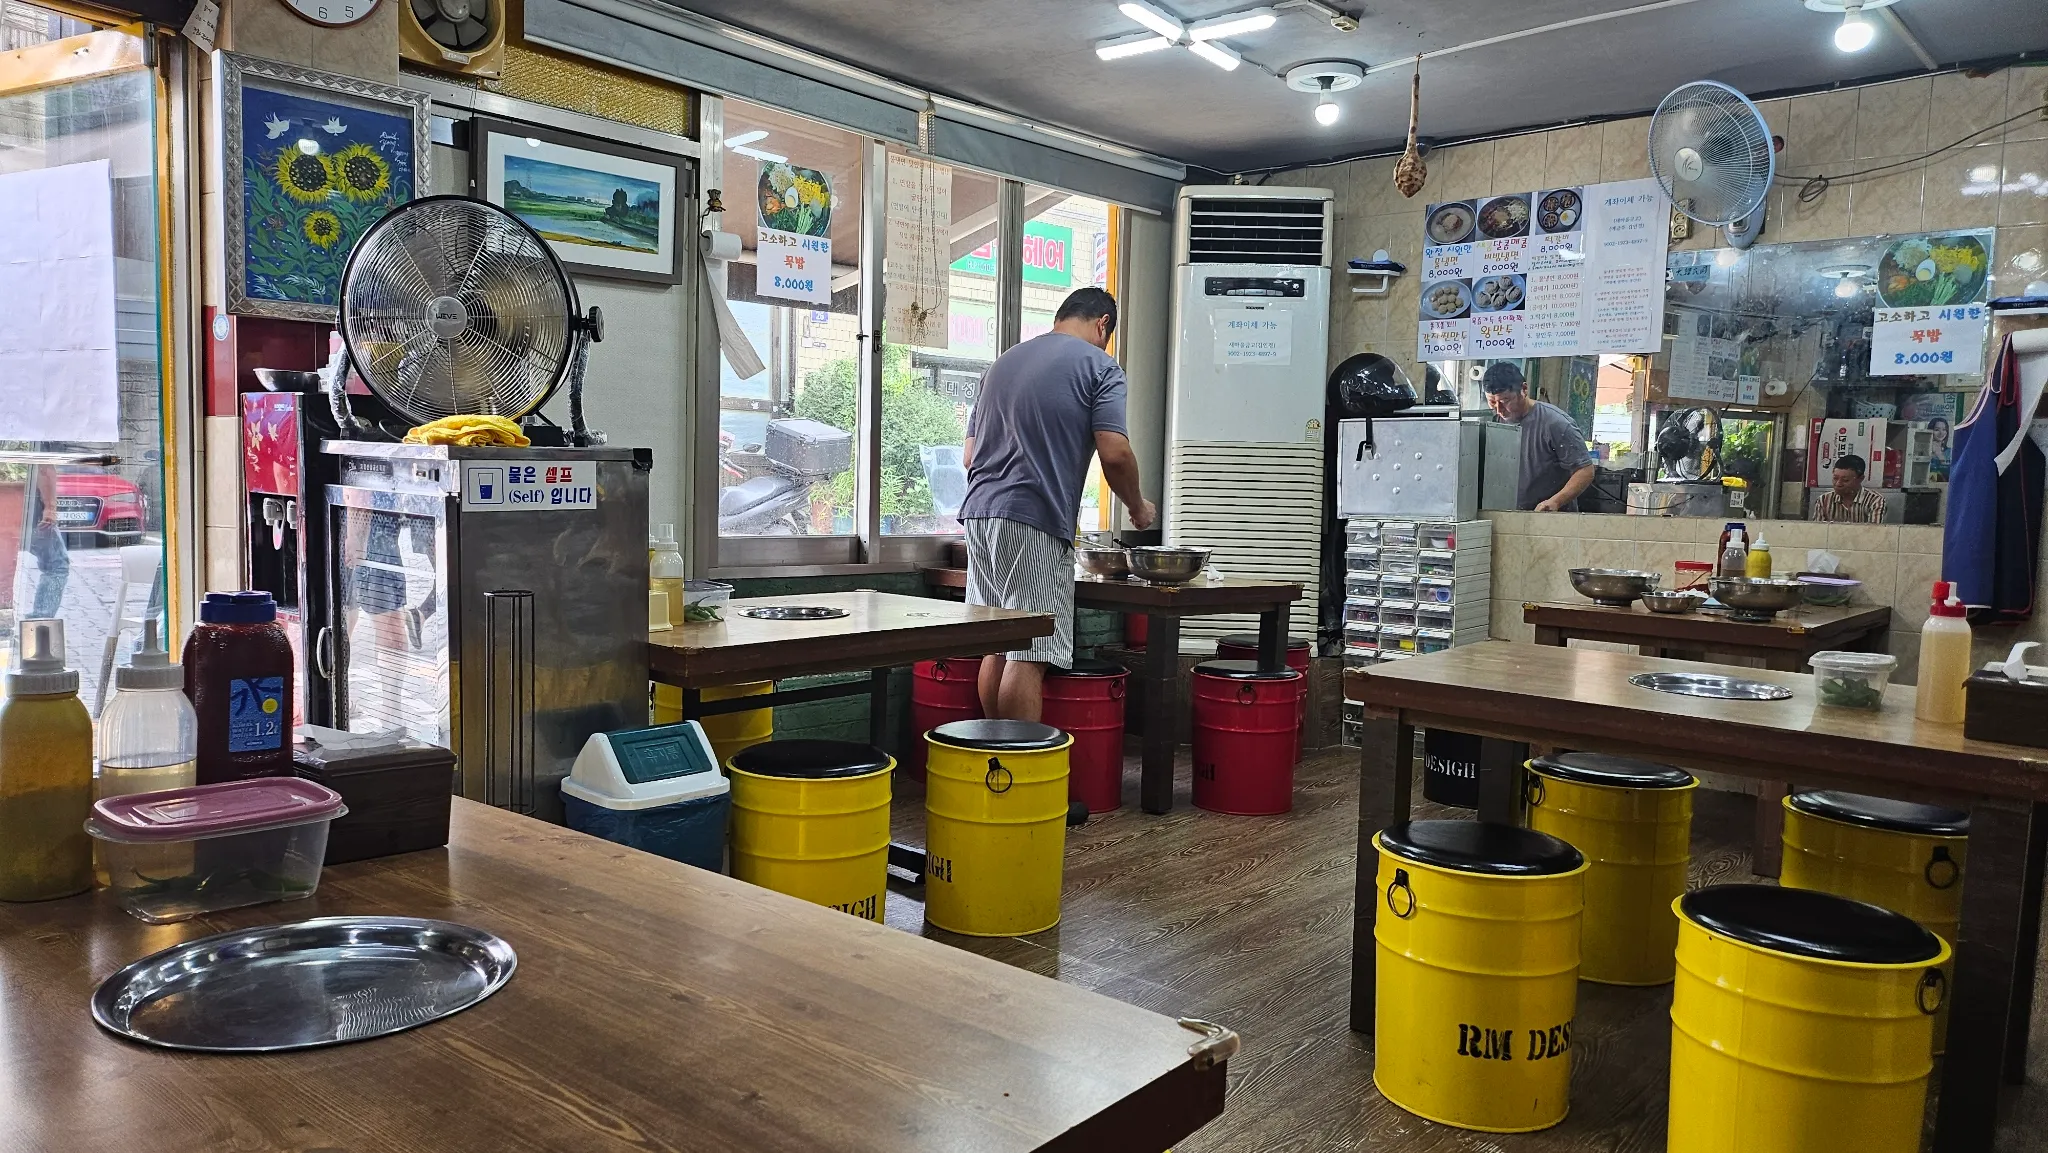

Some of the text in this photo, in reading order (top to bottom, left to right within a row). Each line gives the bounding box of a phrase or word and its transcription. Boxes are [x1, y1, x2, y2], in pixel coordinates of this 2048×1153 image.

[318, 6, 328, 19] 6
[345, 6, 354, 19] 5
[759, 231, 829, 253] 고소하고 시원한
[1540, 242, 1573, 253] 8,000원
[1425, 248, 1443, 258] 완전
[1484, 250, 1520, 263] 비빔냉면
[784, 255, 805, 270] 묵밥
[1433, 256, 1459, 270] 물냉면
[1482, 262, 1519, 274] 8,000원
[1428, 267, 1463, 279] 8,000원
[774, 275, 813, 292] 8,000원
[1875, 306, 1982, 323] 고소하고 시원한
[1228, 320, 1278, 330] 계좌이체 가능
[1480, 324, 1513, 339] 왕만두
[1423, 330, 1468, 344] 감자찐만두
[1910, 328, 1942, 344] 묵밥
[1424, 343, 1463, 355] 7,000원
[1476, 338, 1516, 350] 7,000원
[1894, 350, 1954, 365] 8,000원
[508, 466, 573, 484] 물은 셀프
[508, 486, 592, 505] (Self) 입니다
[1457, 1023, 1513, 1061] RM
